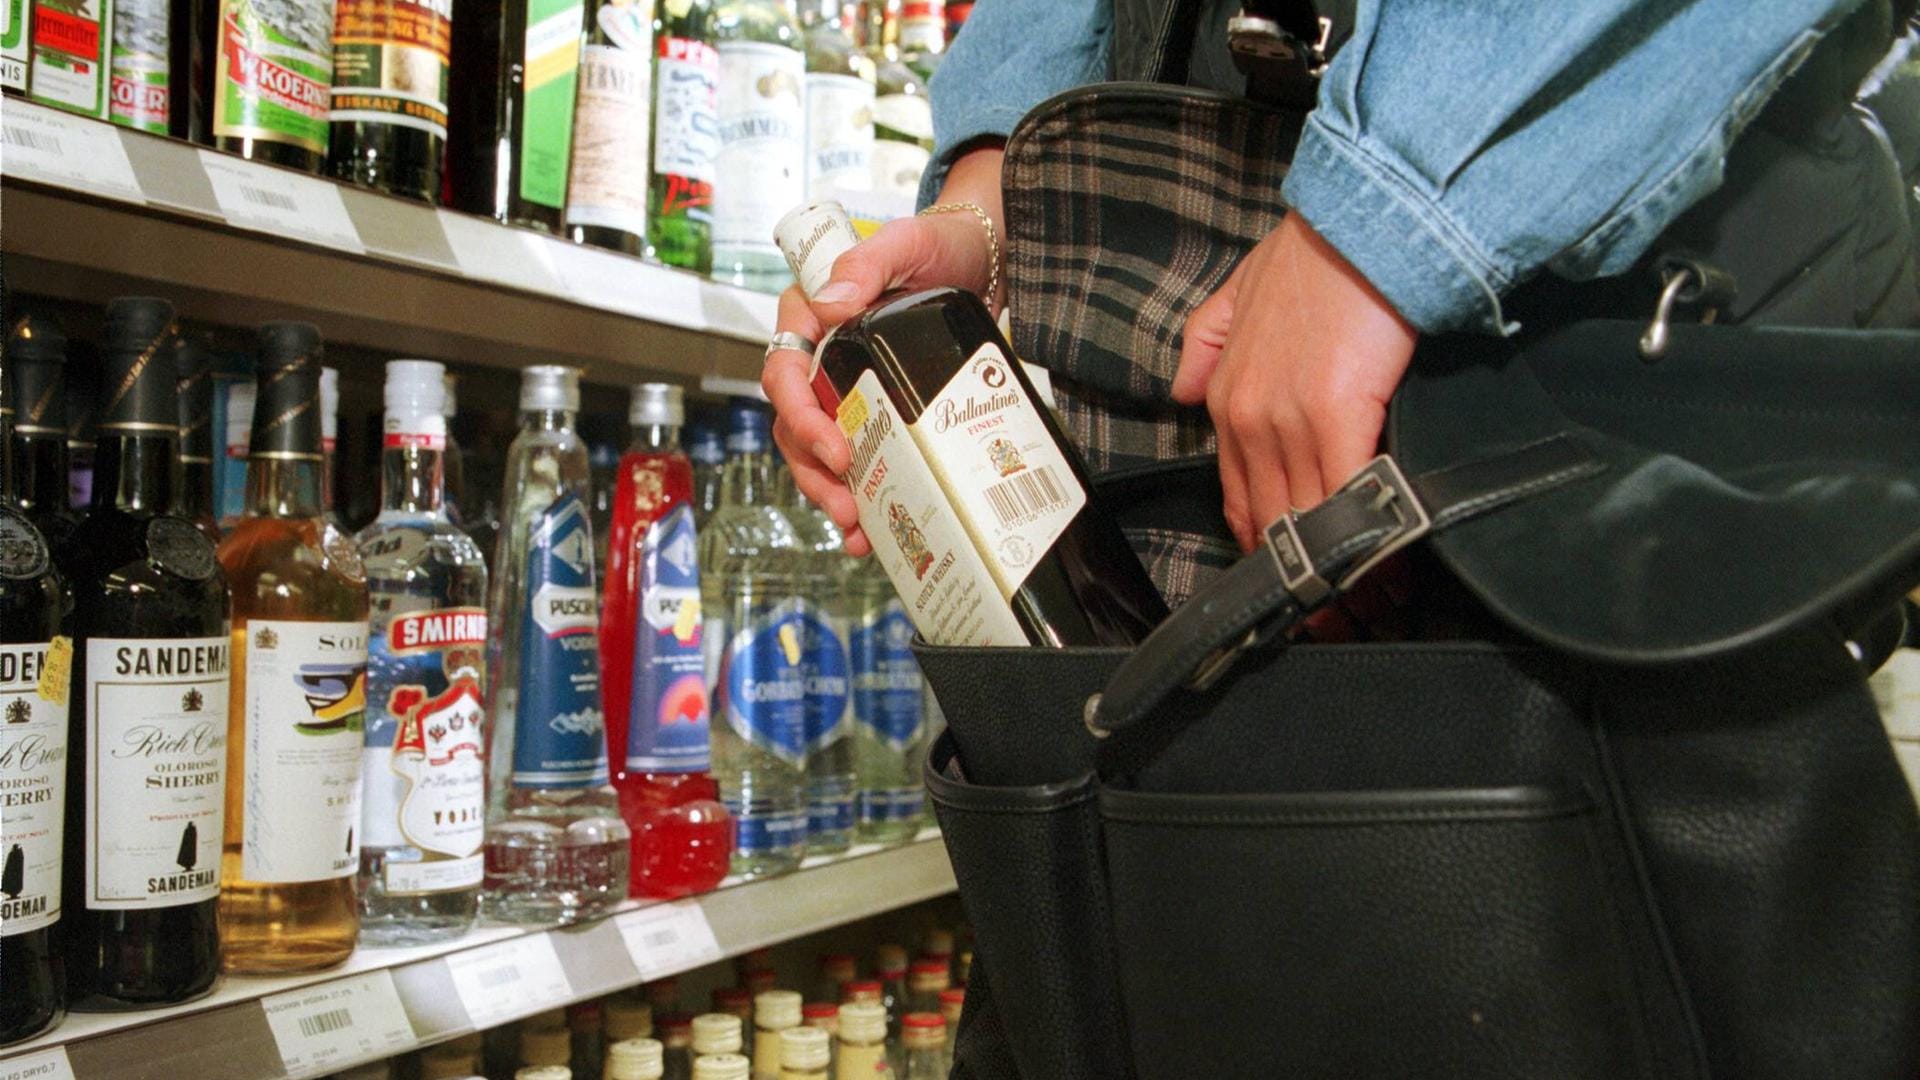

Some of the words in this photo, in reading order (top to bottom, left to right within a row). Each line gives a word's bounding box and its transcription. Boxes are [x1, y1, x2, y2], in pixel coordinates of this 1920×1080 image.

[935, 388, 1020, 433] Ballantine's
[967, 415, 1005, 436] FINEST
[154, 758, 218, 773] OLOROSO
[145, 771, 220, 789] SHERRY
[147, 869, 215, 894] SANDEMAN
